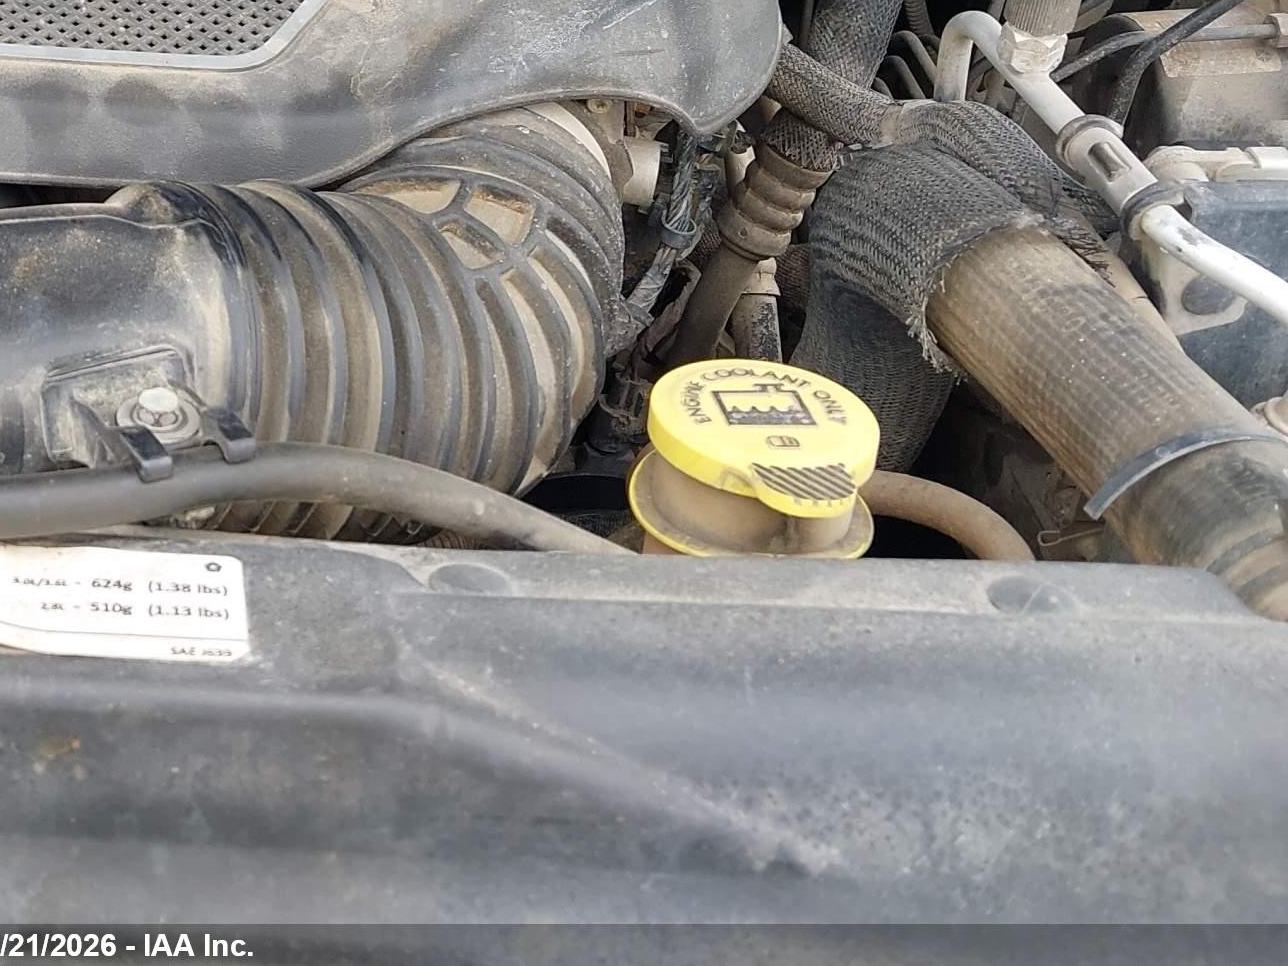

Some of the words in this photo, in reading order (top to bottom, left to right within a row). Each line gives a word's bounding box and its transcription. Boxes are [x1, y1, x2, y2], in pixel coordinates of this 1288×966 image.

[681, 380, 713, 424] ENGINE
[702, 367, 812, 388] COOLANT
[812, 389, 848, 425] ONLY
[92, 578, 132, 592] 624g
[148, 580, 191, 594] (1.38
[197, 583, 228, 596] lbs)
[91, 601, 132, 616] 510g
[148, 603, 191, 617] (1.13
[198, 606, 229, 620] lbs)
